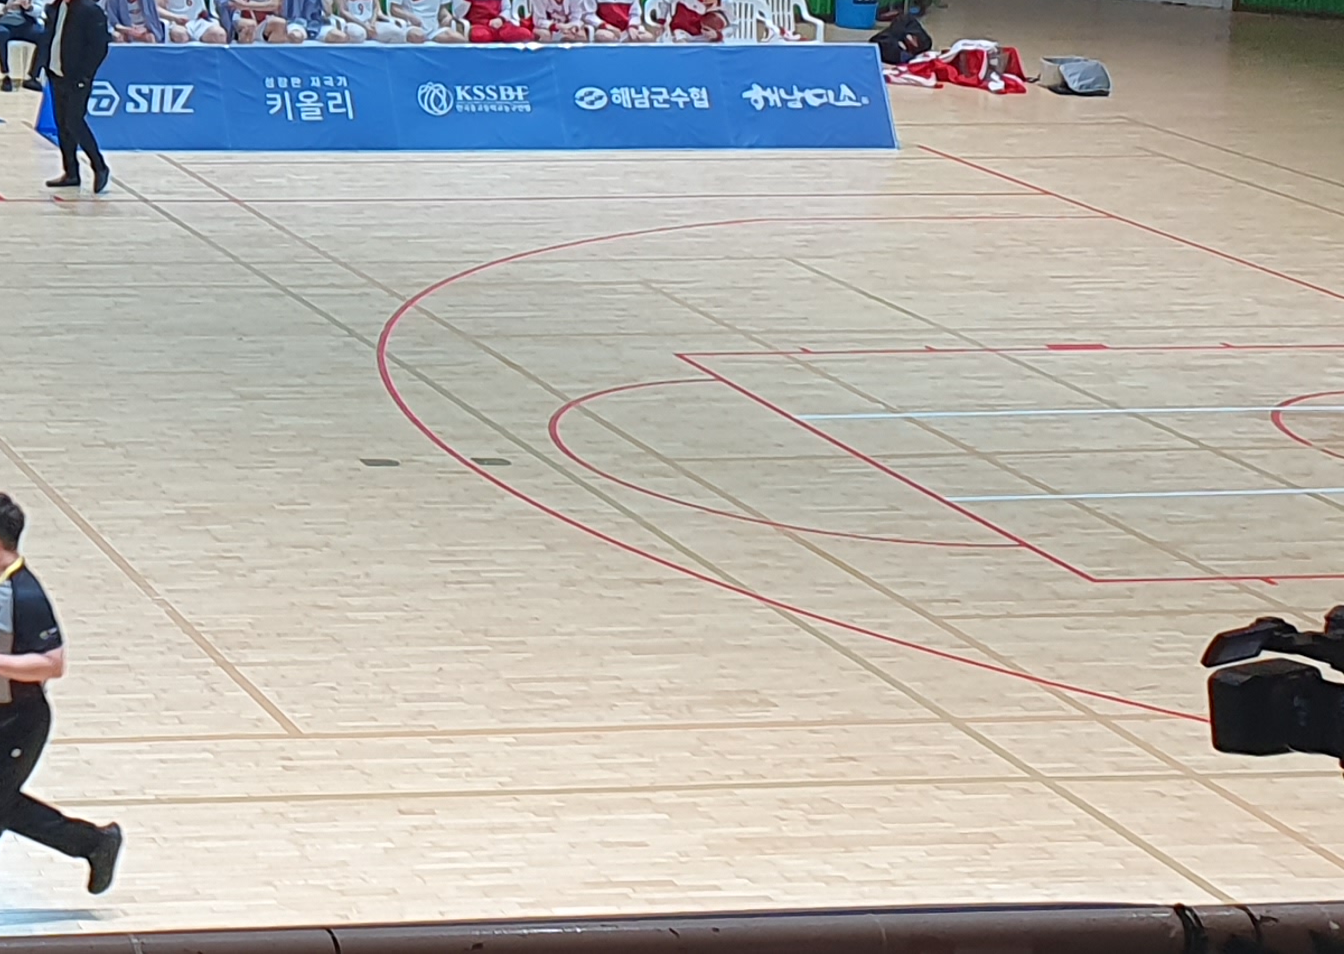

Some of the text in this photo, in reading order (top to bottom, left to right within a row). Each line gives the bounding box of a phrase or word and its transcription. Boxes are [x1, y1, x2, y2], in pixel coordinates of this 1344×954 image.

[126, 85, 194, 113] STIZ
[266, 89, 354, 121] 키올리
[455, 85, 530, 101] KSSBF
[610, 86, 709, 110] 해남군수협
[741, 83, 863, 112] 해남미소
